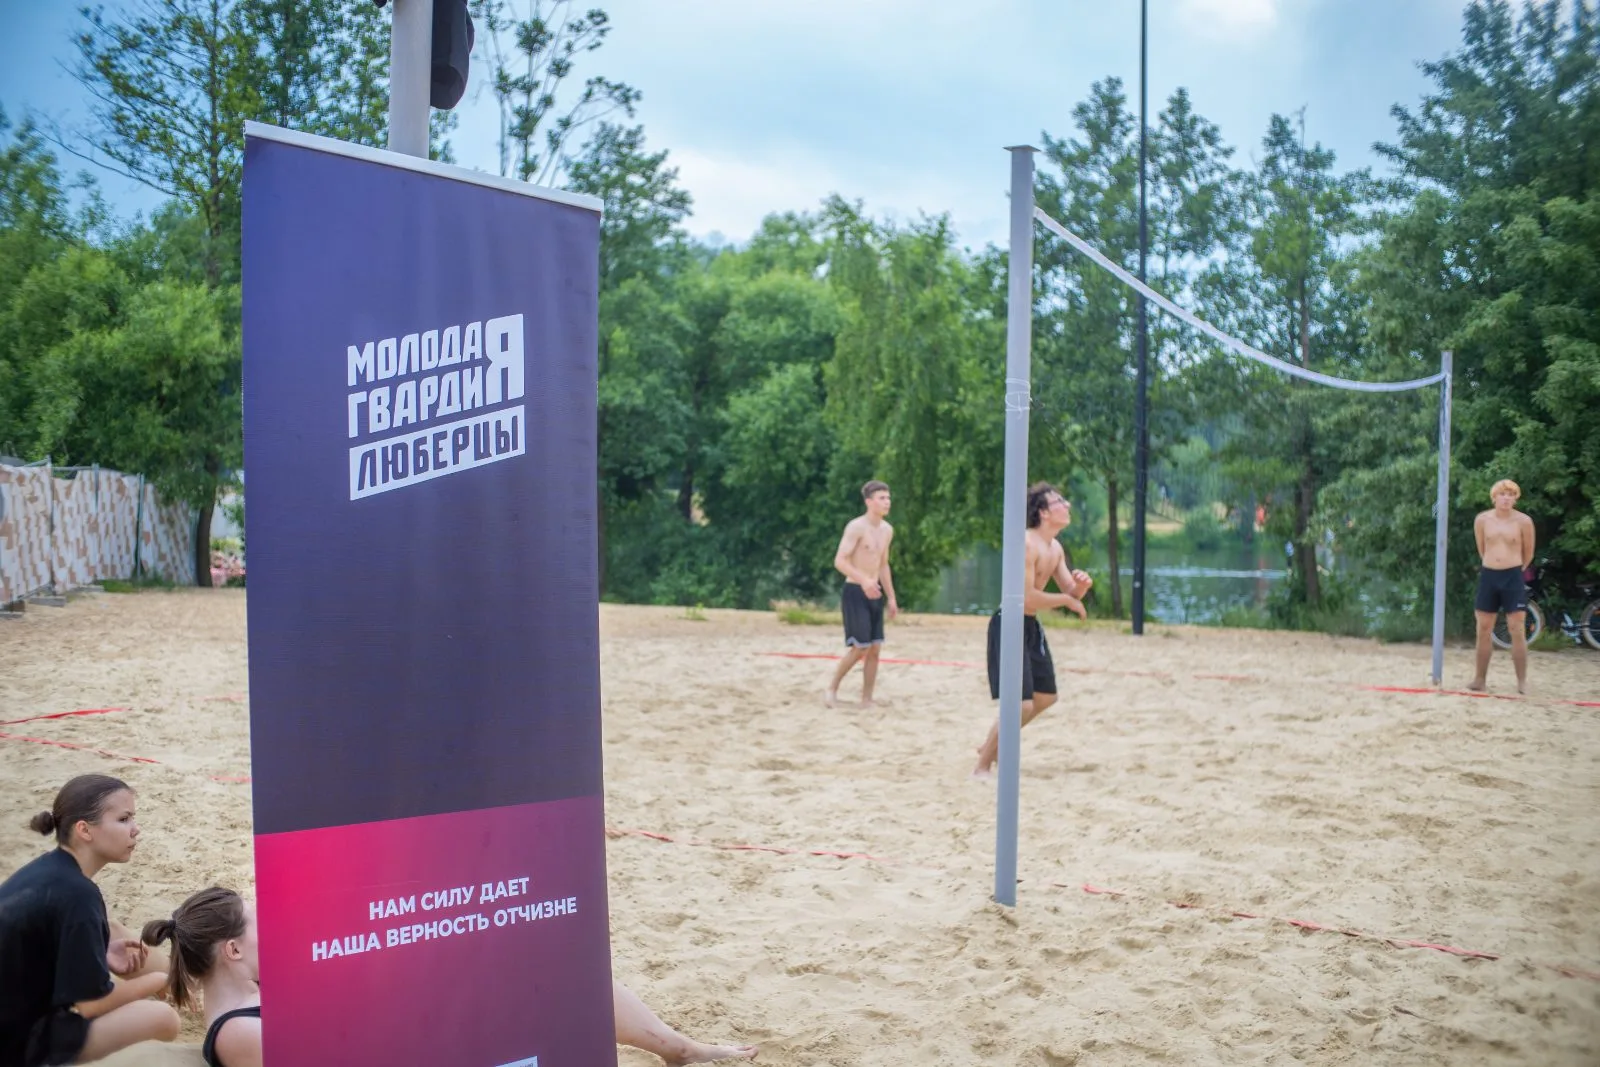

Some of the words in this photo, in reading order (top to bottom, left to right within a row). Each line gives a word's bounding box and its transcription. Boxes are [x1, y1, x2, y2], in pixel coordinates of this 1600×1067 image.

[357, 415, 518, 492] ЛЮБЕРЦЫ
[312, 931, 382, 962] НАША
[386, 912, 489, 948] ВЕРНОСТЬ
[493, 897, 578, 927] ОТЧИЗНЕ
[369, 896, 416, 921] НАМ
[420, 886, 475, 910] СИЛУ
[480, 877, 530, 904] ДАЕТ
